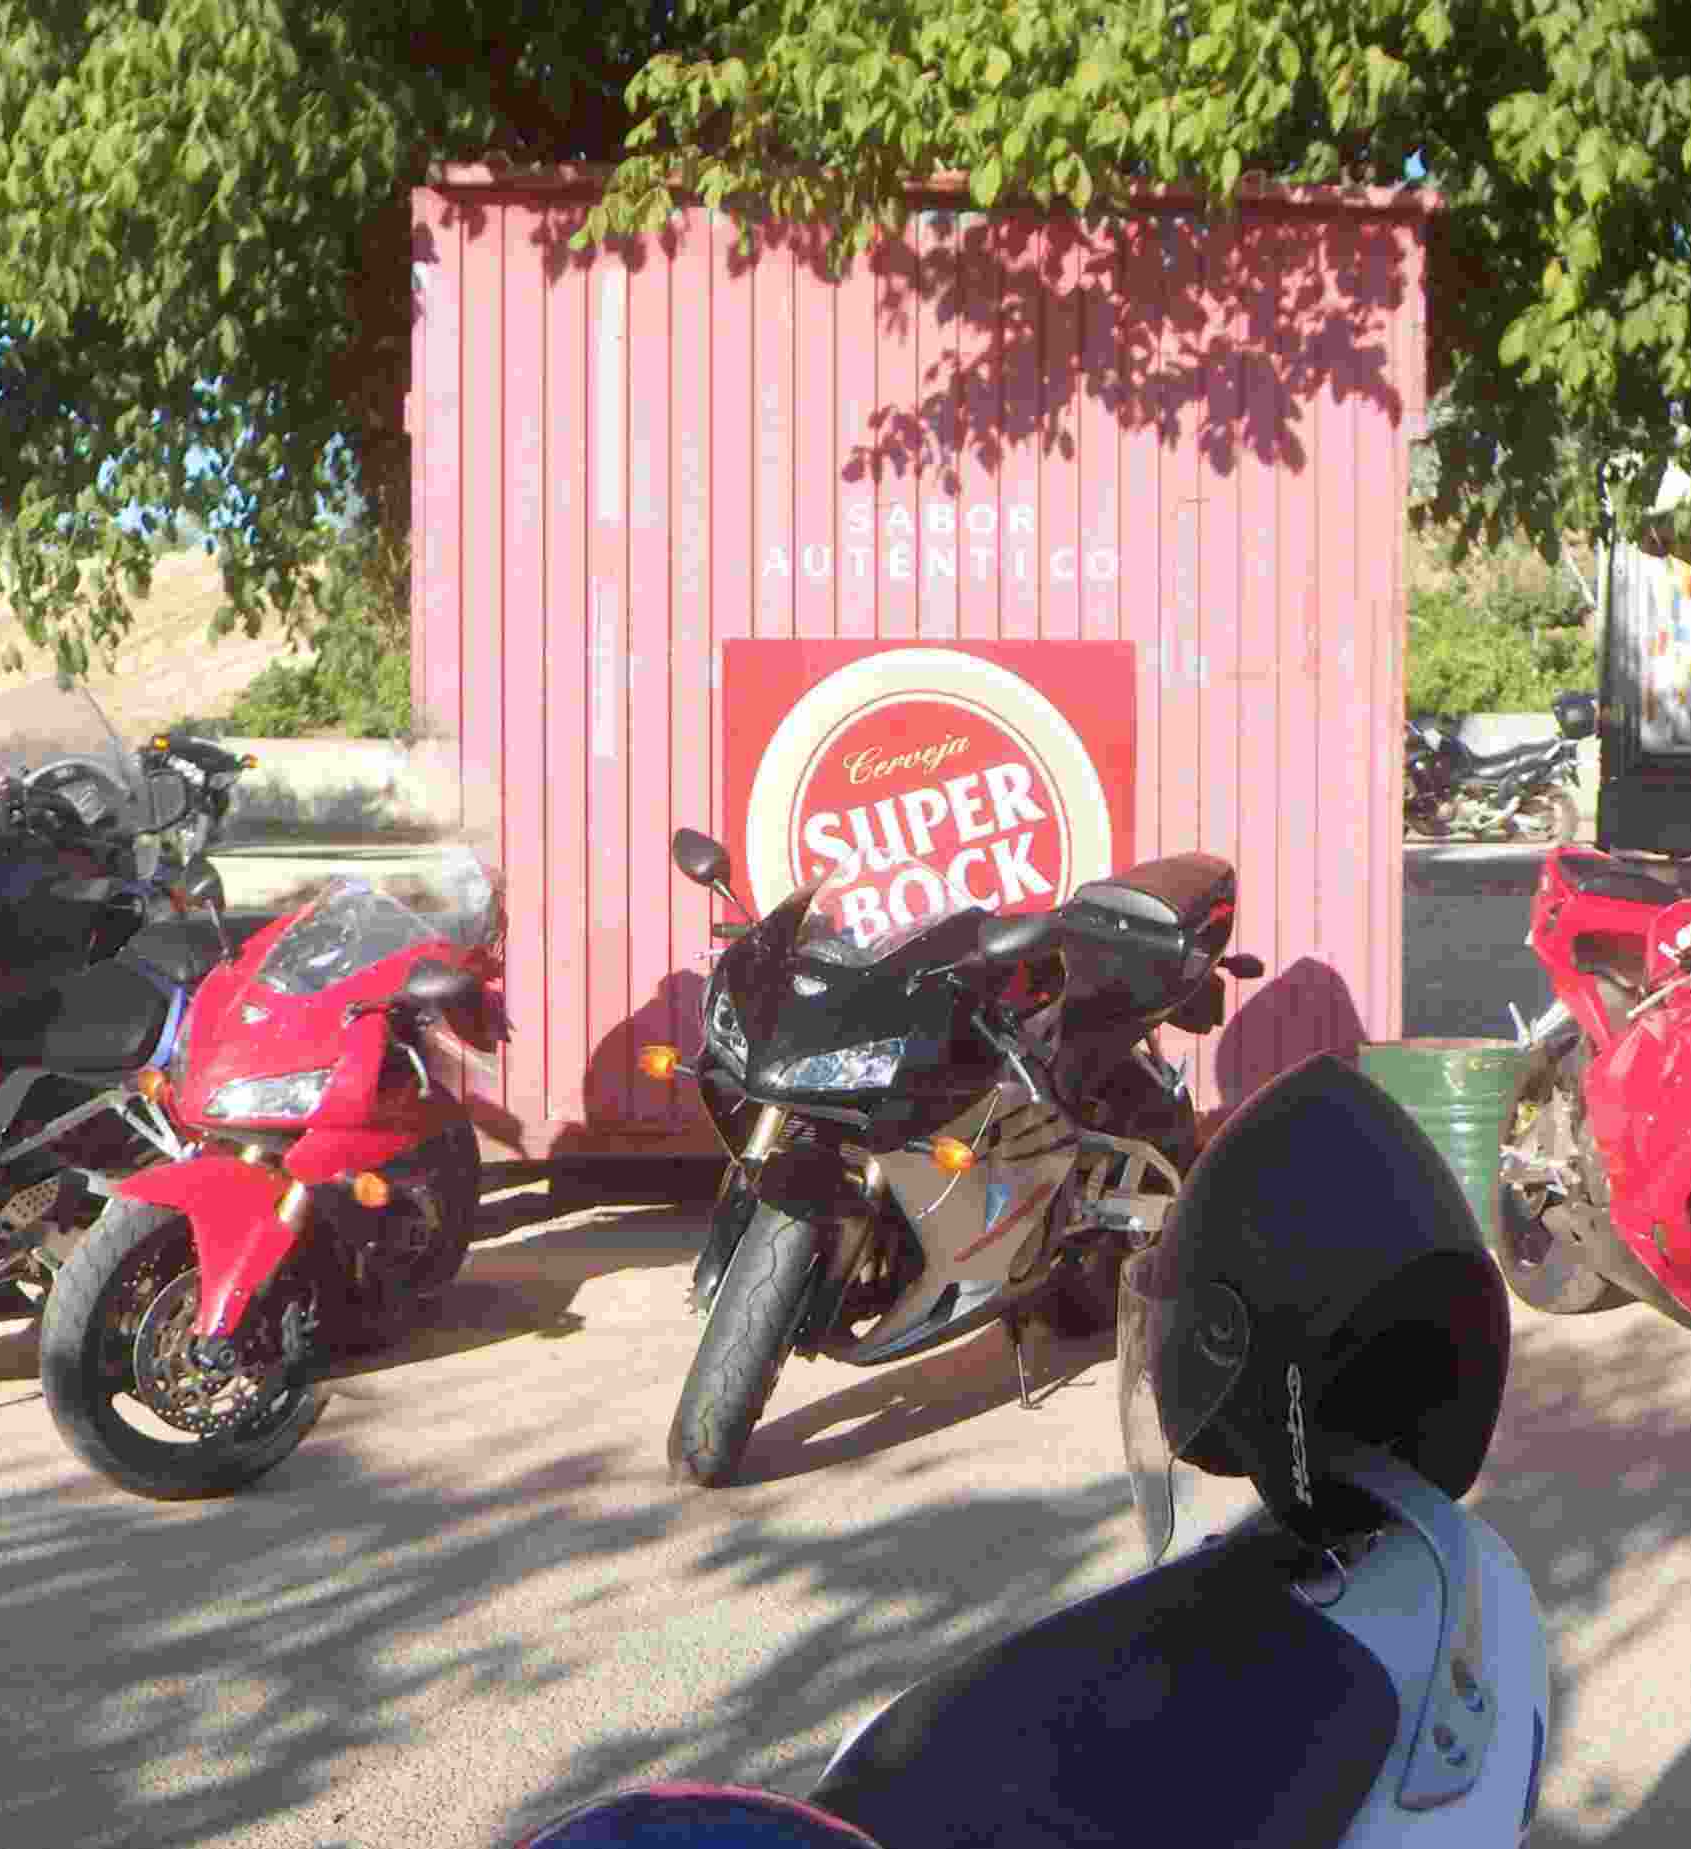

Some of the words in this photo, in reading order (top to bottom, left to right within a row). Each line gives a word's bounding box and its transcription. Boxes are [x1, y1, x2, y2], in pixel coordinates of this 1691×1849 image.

[848, 502, 1035, 535] SABOR
[843, 730, 970, 784] Cerveja
[804, 762, 1048, 884] SUPER
[840, 832, 1054, 949] BOCK
